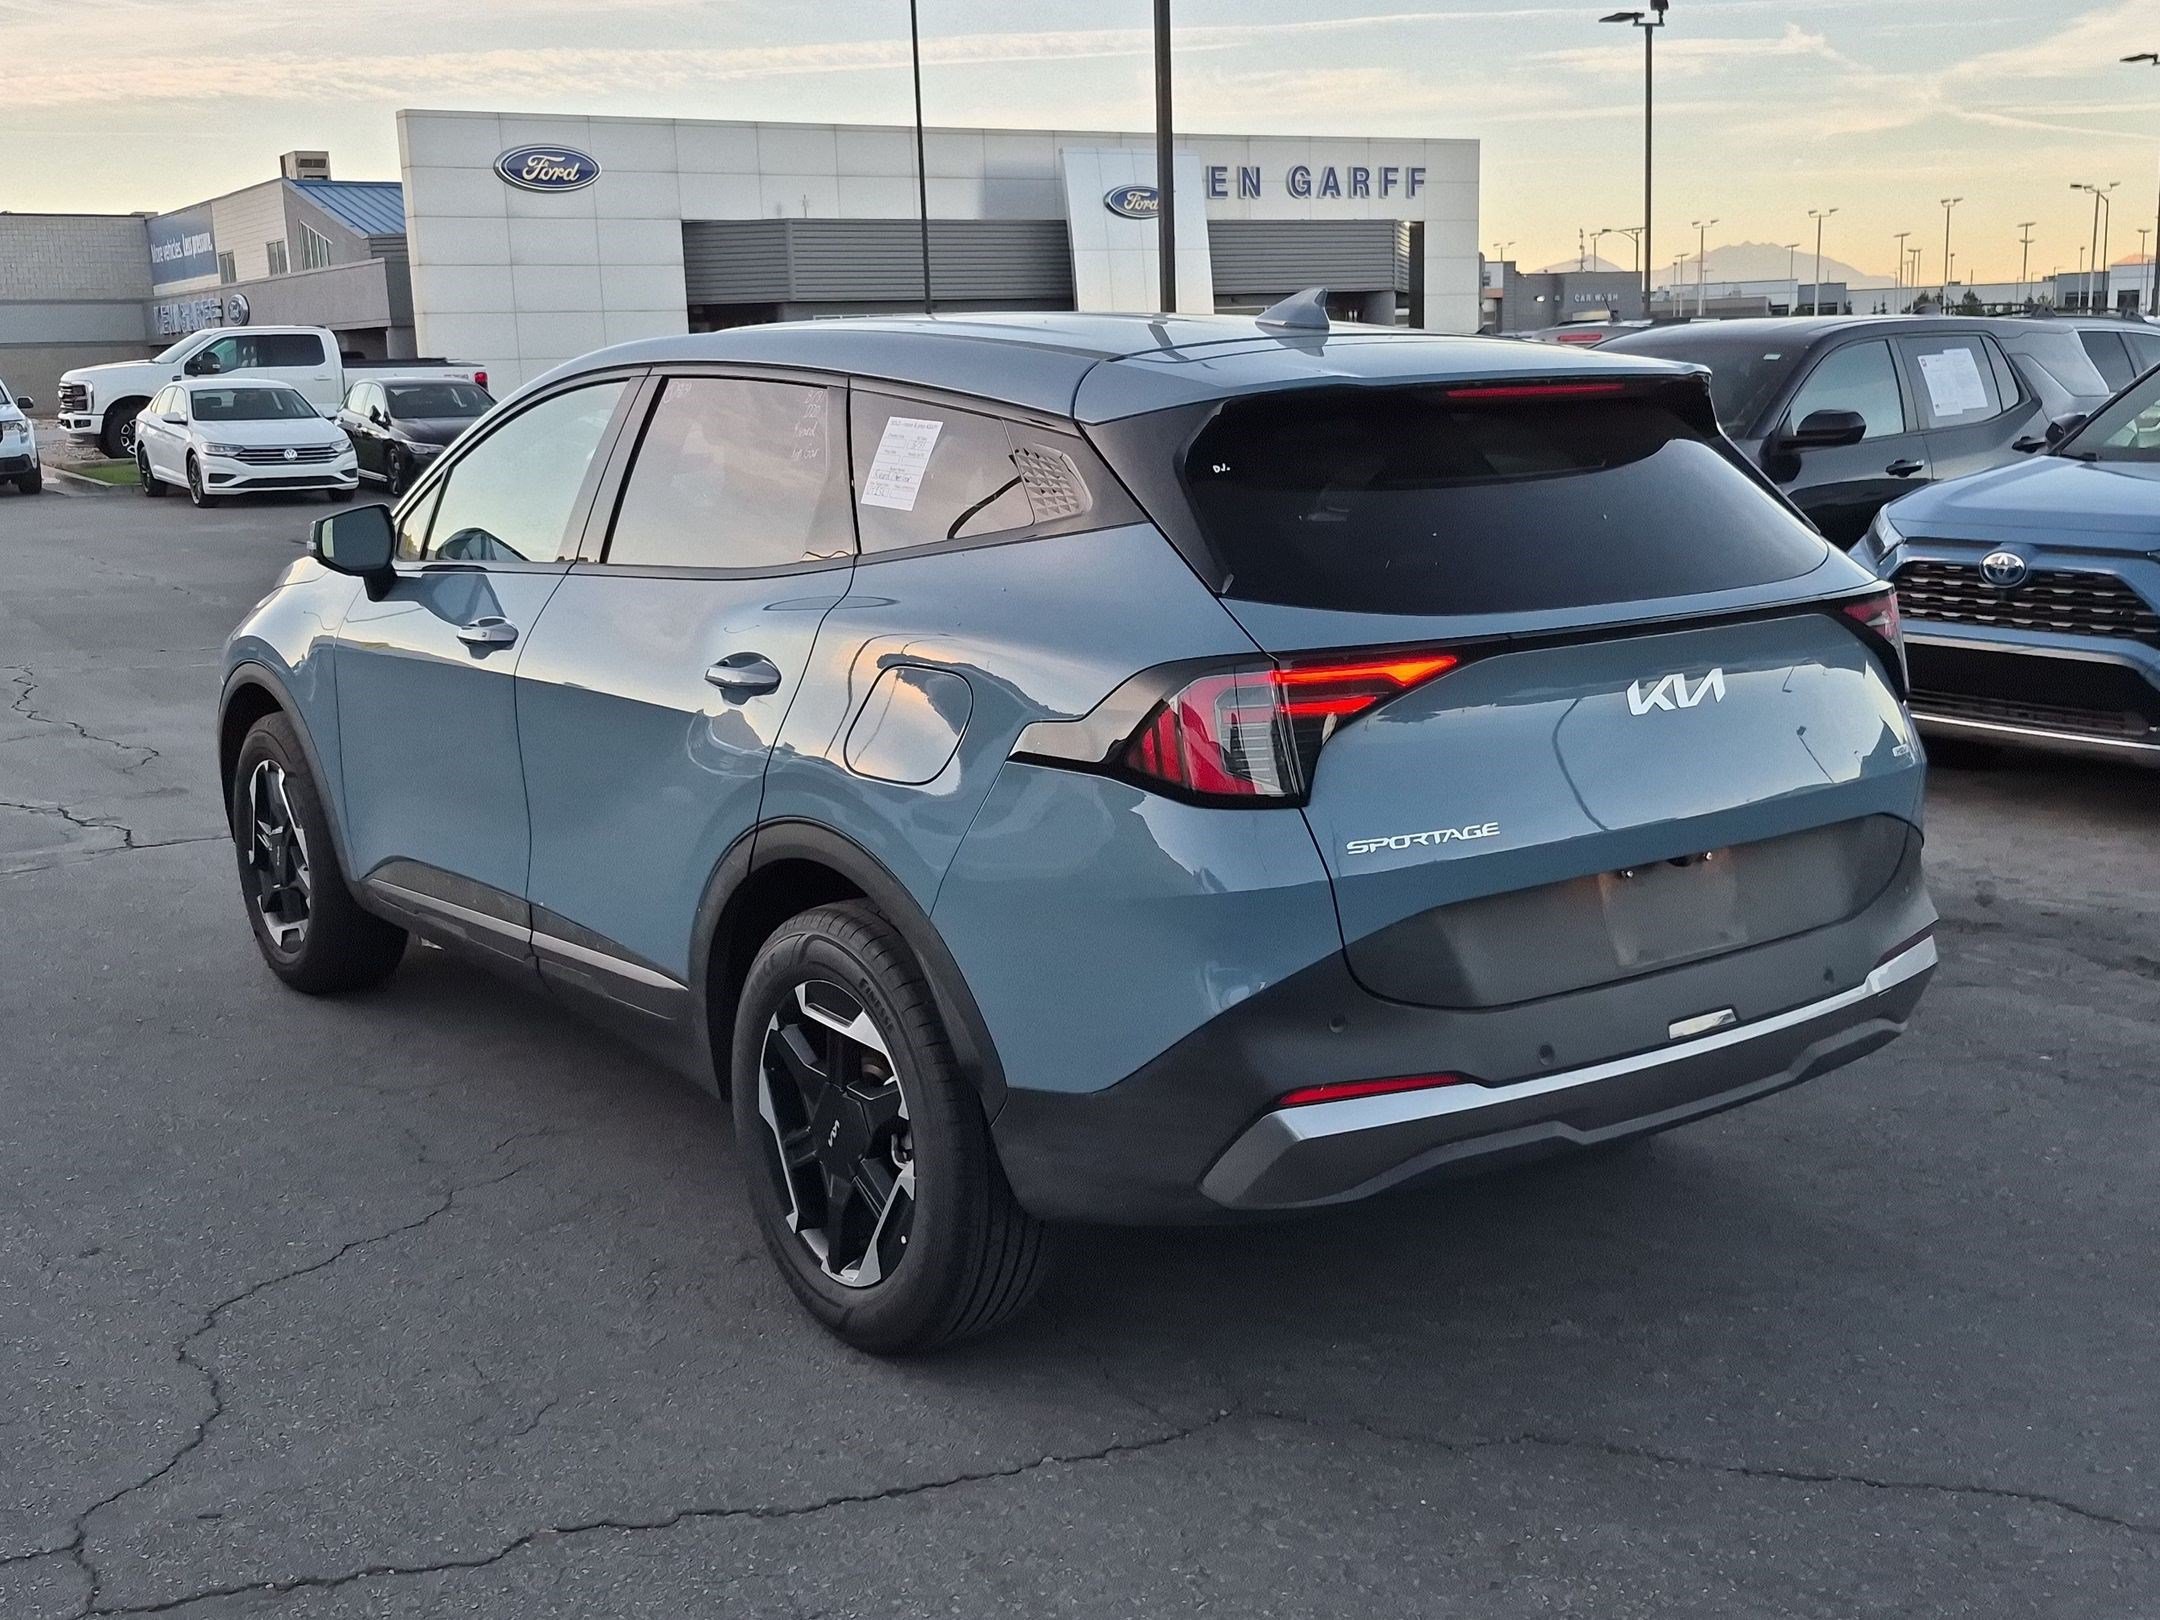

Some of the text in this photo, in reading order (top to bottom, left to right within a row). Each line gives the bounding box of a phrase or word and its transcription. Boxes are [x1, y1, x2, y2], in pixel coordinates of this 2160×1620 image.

[522, 154, 580, 181] Ford
[1207, 165, 1427, 199] EN GARFF
[1574, 294, 1591, 302] CAR
[1626, 667, 1726, 716] KIA
[1346, 822, 1501, 855] SPORTAGE
